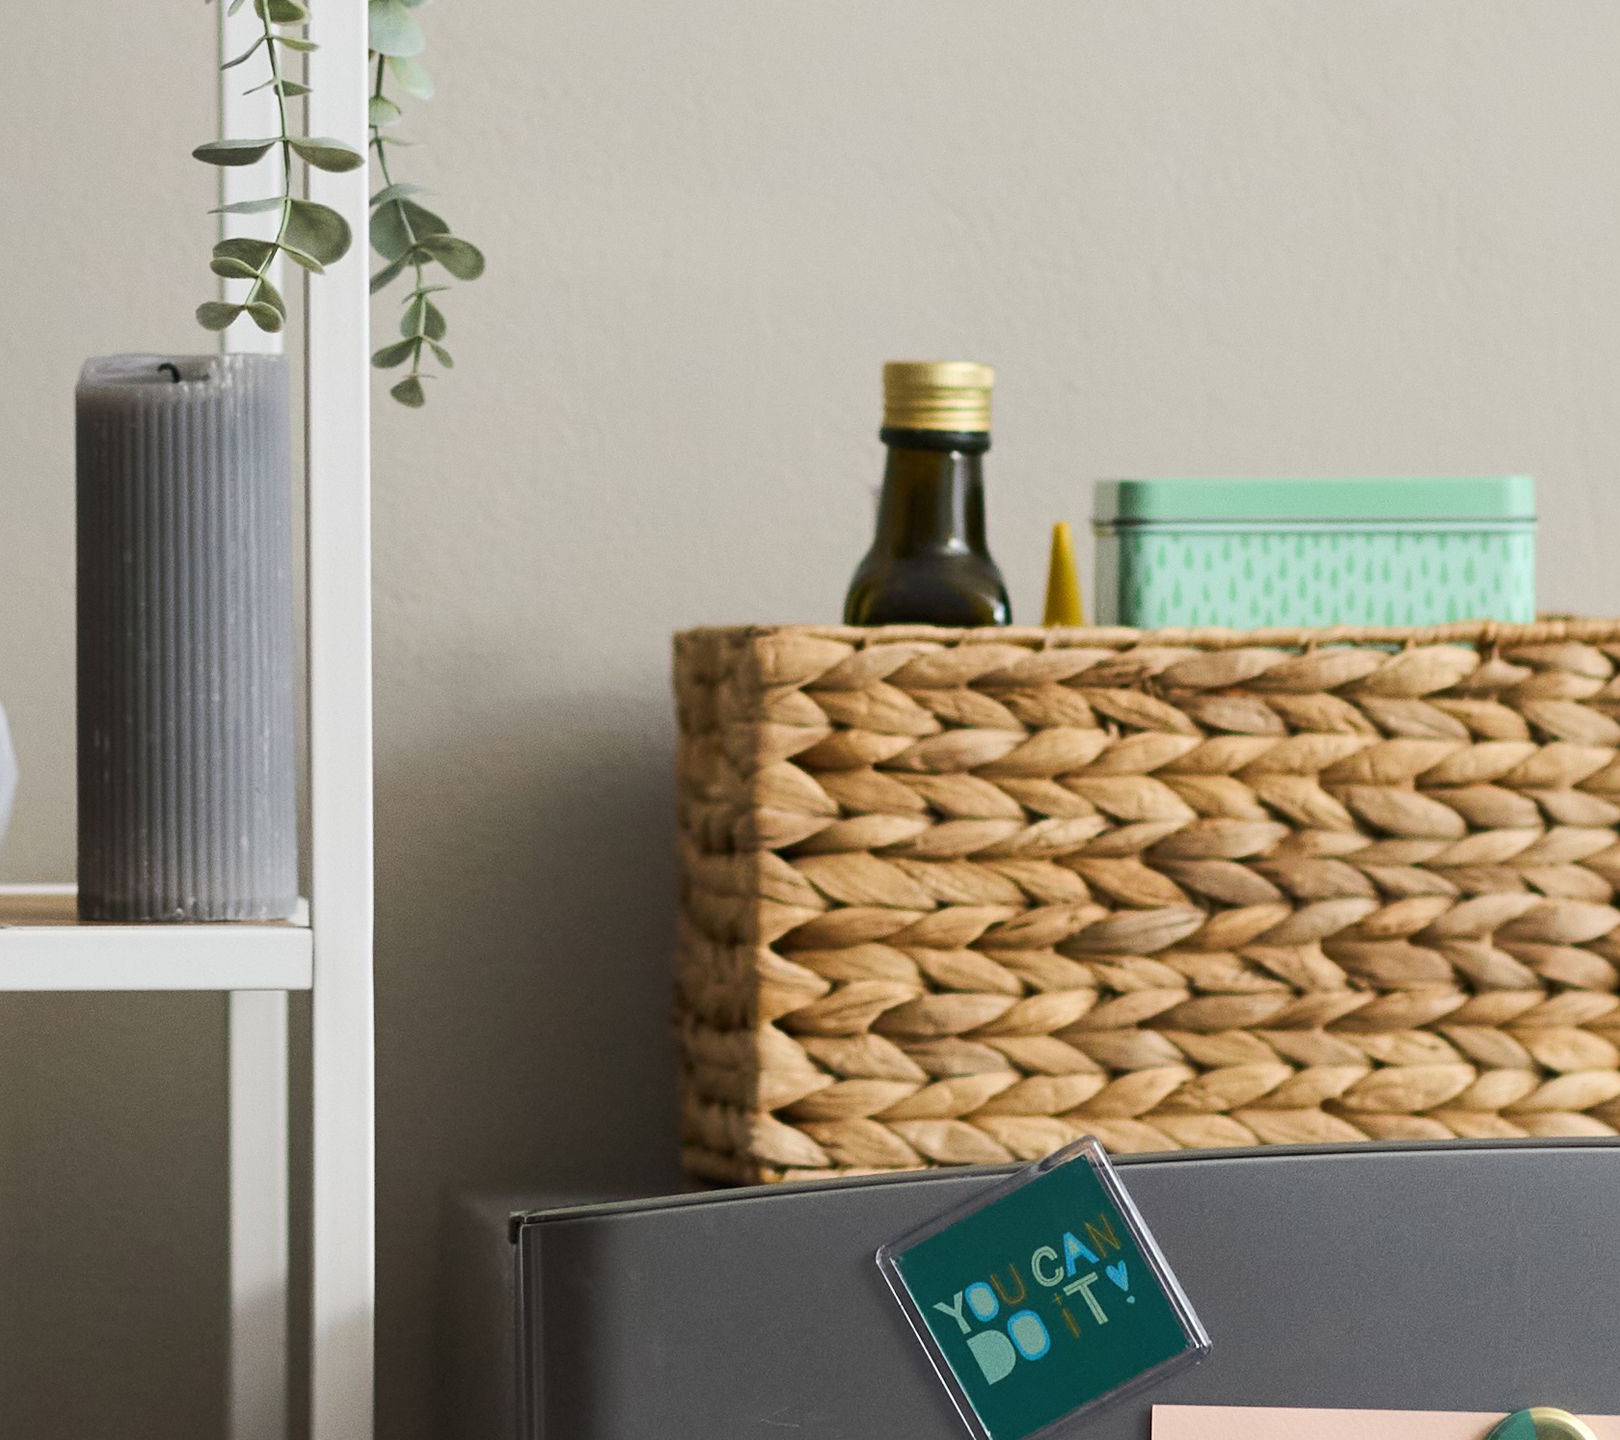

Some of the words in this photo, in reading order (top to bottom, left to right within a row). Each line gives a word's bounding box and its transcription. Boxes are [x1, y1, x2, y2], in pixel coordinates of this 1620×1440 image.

[933, 1262, 1027, 1335] YOU
[1031, 1213, 1121, 1288] CAN
[966, 1309, 1051, 1386] DO
